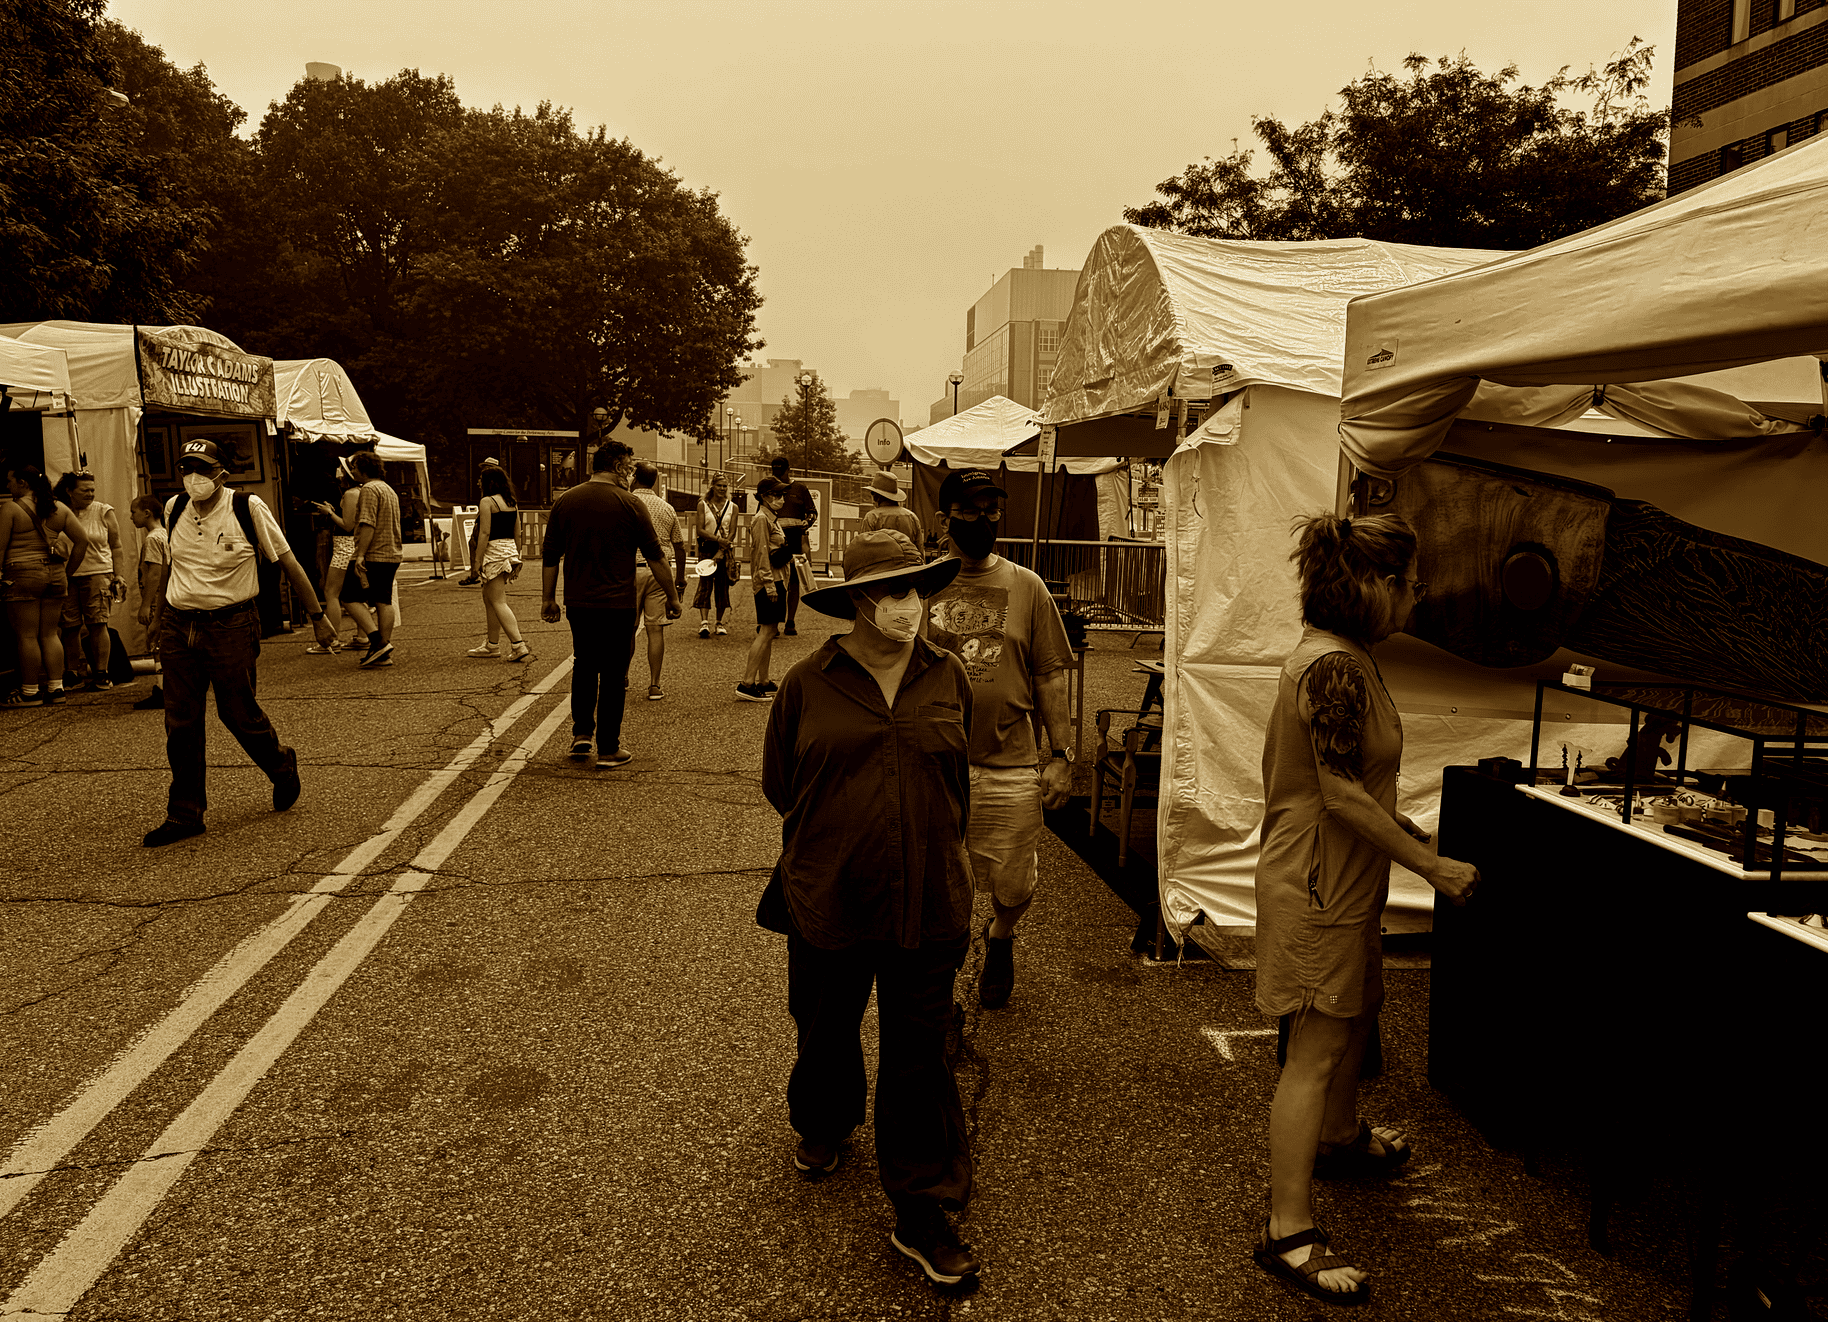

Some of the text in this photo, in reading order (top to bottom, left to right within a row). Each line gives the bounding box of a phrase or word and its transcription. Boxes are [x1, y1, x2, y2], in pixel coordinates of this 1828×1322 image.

[162, 346, 205, 374] TAYLOR
[170, 373, 249, 403] ILLUSTRATION
[877, 438, 891, 446] Info
